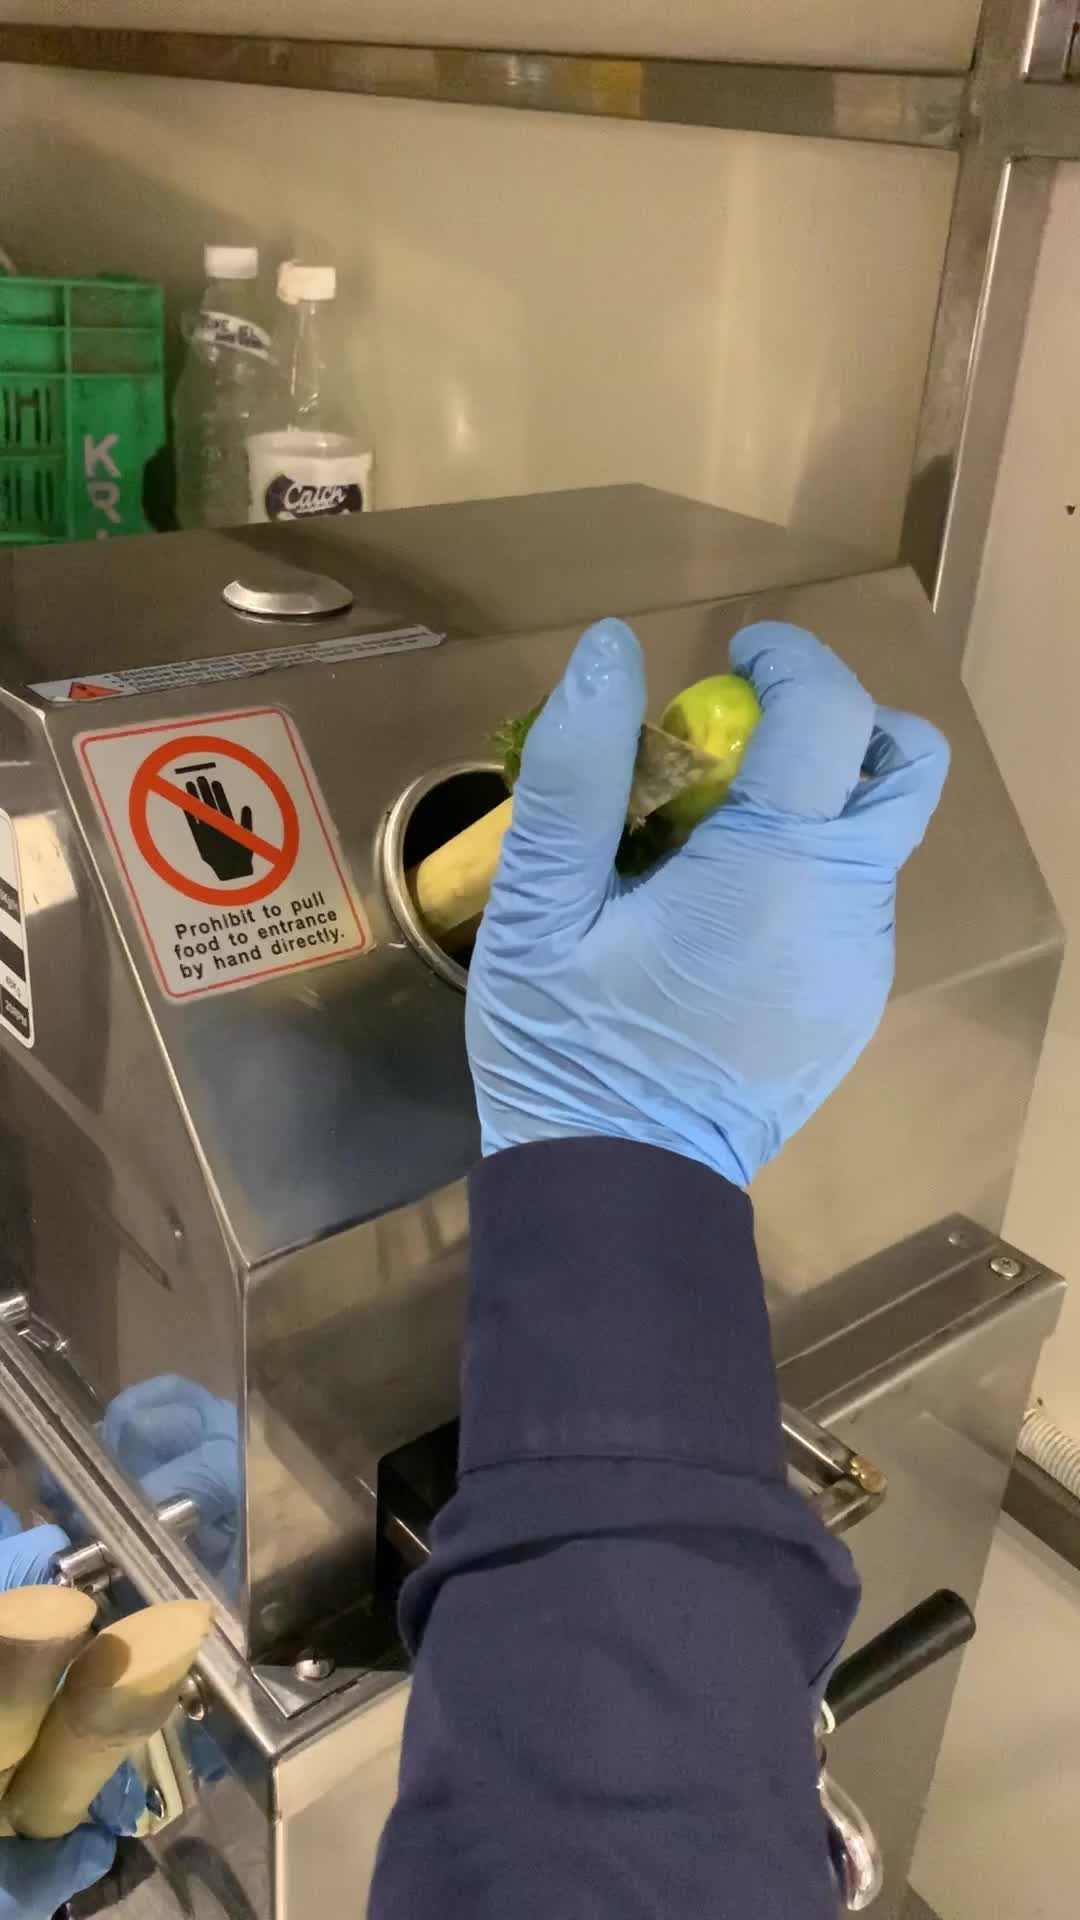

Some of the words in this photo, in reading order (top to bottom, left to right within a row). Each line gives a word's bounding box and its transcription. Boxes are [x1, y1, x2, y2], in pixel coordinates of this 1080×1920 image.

[84, 432, 121, 541] KR
[174, 936, 220, 960] food
[228, 932, 248, 946] to
[258, 910, 337, 939] entrance
[175, 908, 256, 939] Prohibit
[262, 905, 282, 919] to
[290, 891, 325, 915] pull
[179, 963, 203, 980] by
[213, 945, 262, 970] hand
[271, 928, 345, 955] directly.
